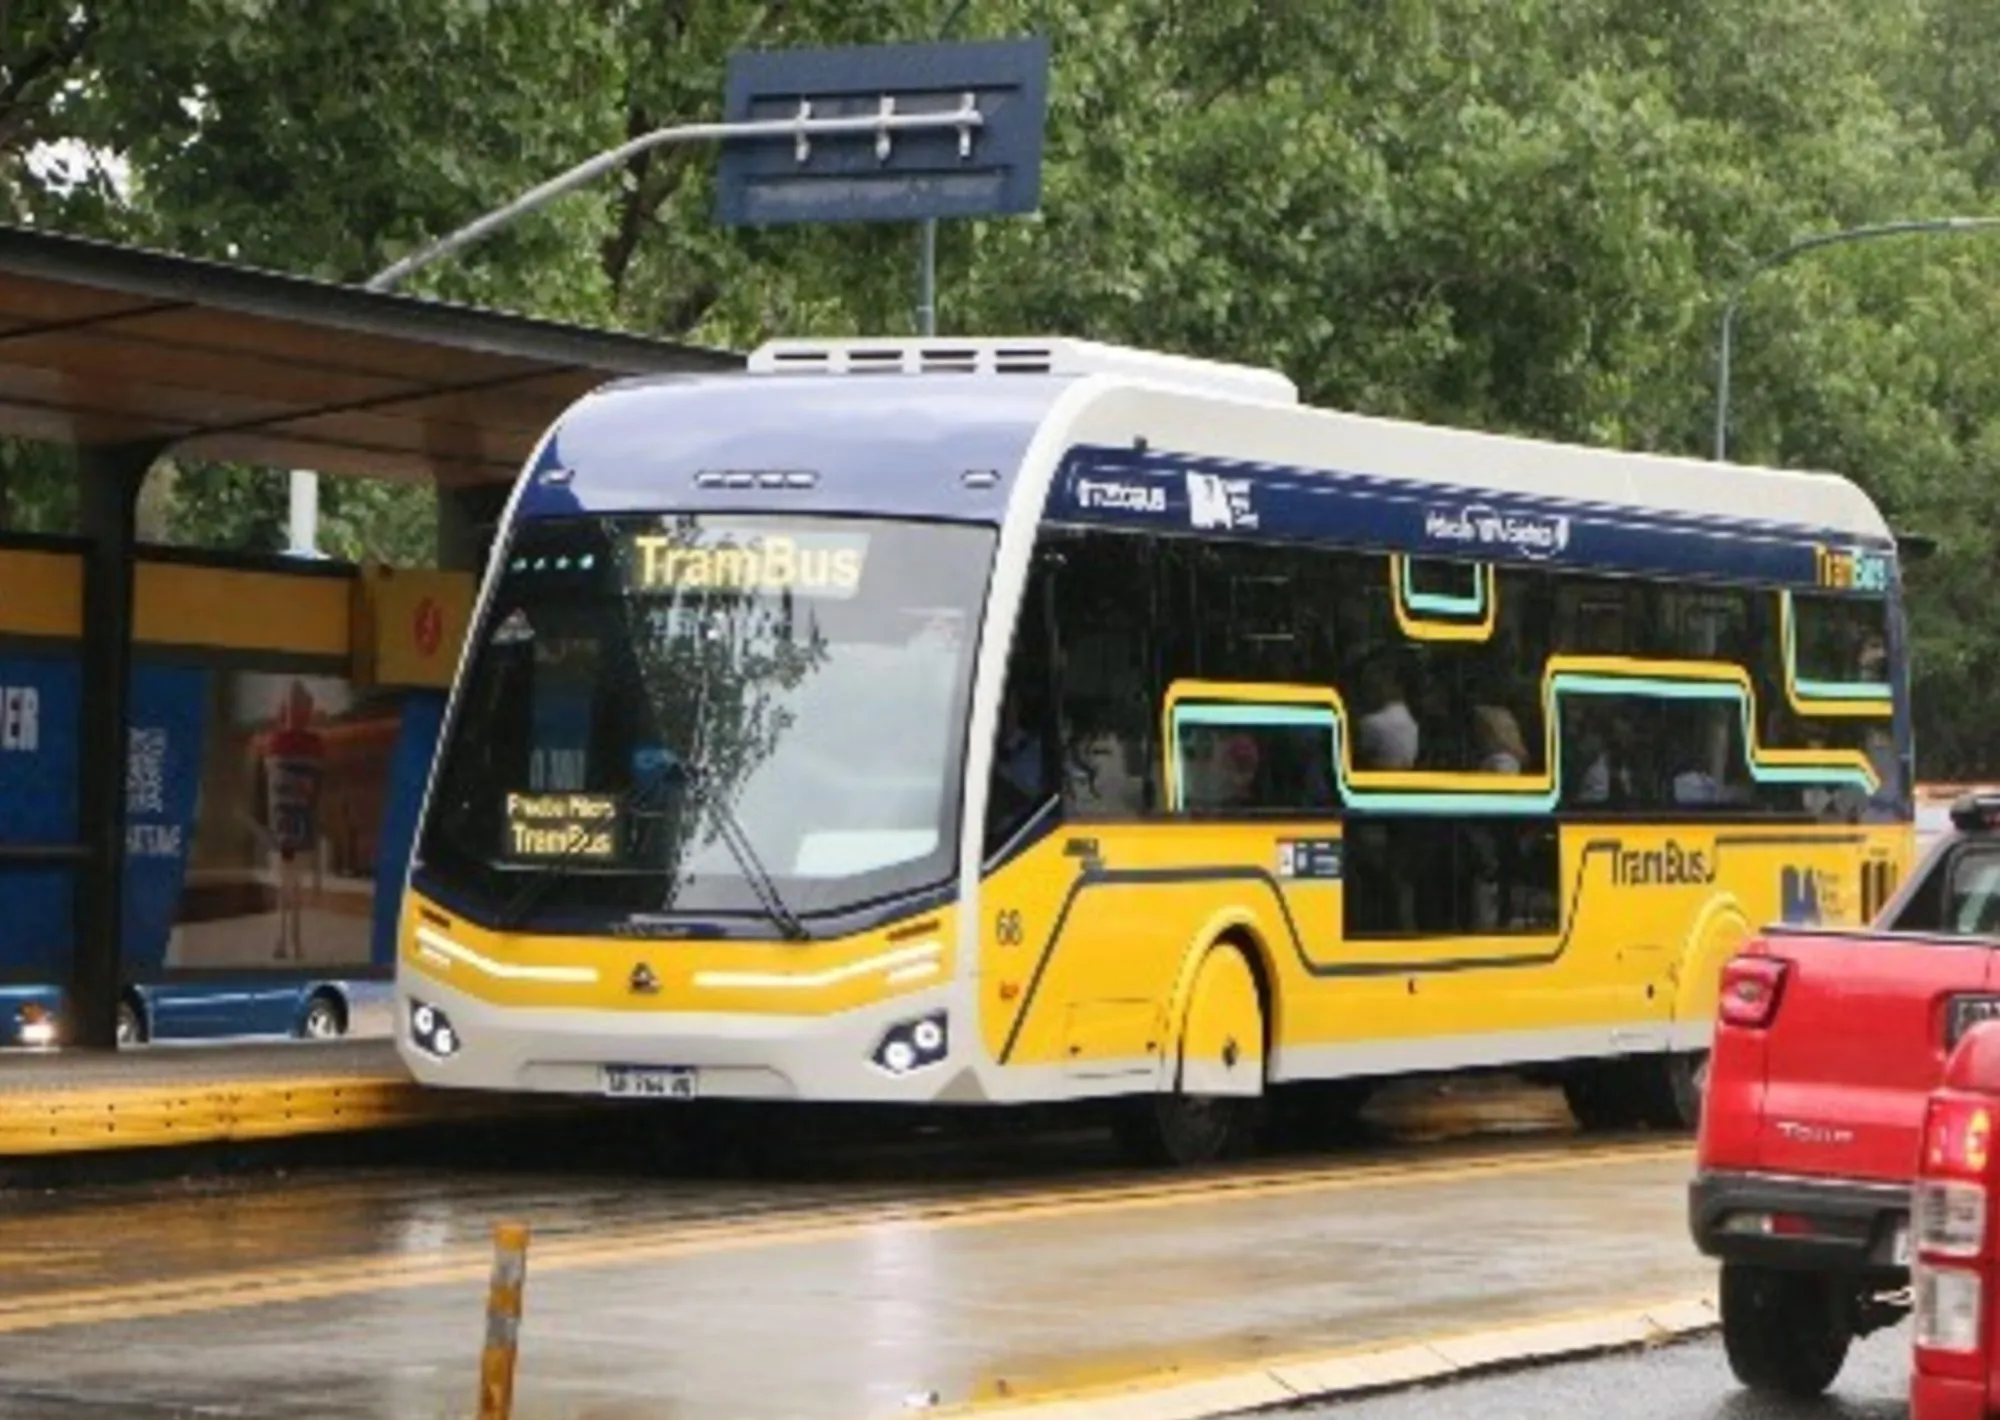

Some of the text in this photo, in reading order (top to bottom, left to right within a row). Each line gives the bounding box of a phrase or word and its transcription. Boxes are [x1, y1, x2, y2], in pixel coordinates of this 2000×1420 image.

[635, 534, 862, 587] TramBus
[0, 685, 39, 751] ER
[511, 822, 612, 855] TramBus
[1608, 837, 1704, 888] TramBus
